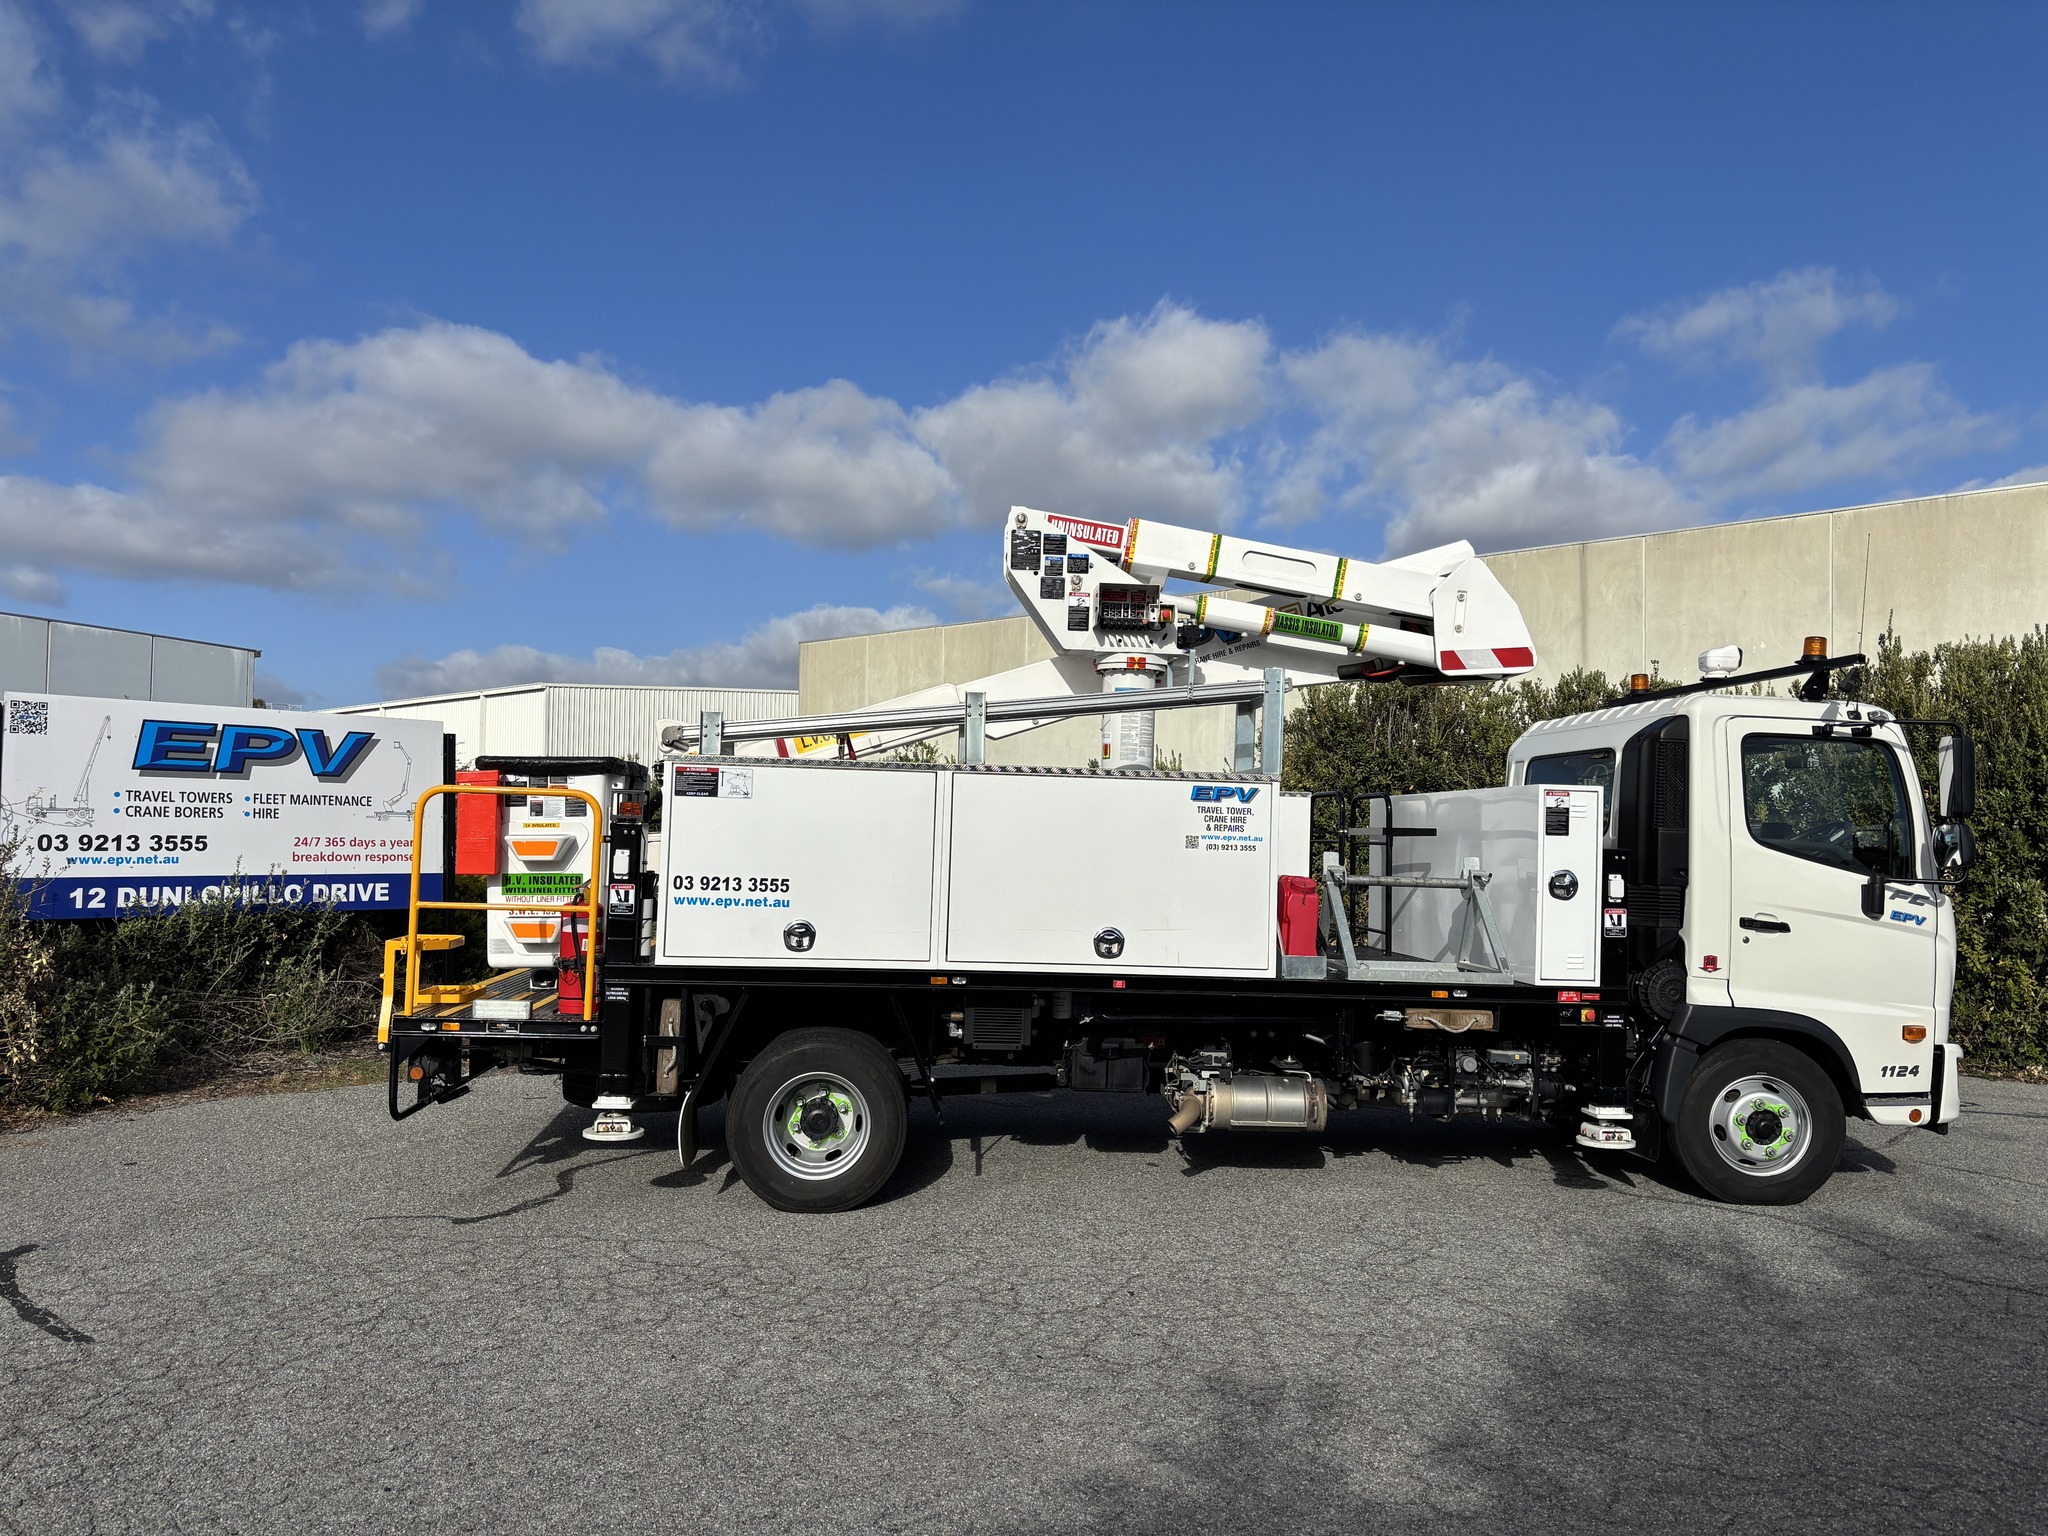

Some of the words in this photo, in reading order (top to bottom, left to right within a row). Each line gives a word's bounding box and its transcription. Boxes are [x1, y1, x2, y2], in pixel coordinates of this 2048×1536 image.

[1301, 619, 1339, 638] INSULATOR
[1194, 653, 1211, 664] RANE
[1212, 649, 1227, 660] HIRE
[1228, 647, 1233, 655] &
[1234, 639, 1261, 653] REPAIRS
[131, 719, 381, 784] EPV
[125, 790, 176, 803] TRAVEL
[179, 791, 233, 804] TOWERS
[253, 793, 287, 805] FLEET
[290, 794, 372, 807] MAINTENANCE
[1190, 785, 1261, 804] EPV
[125, 805, 170, 818] CRANE
[174, 806, 224, 819] BORERS
[252, 808, 280, 819] HIRE
[1197, 806, 1224, 814] TRAVEL
[1226, 807, 1254, 816] TOWER,
[1204, 814, 1228, 823] CRANE
[1230, 815, 1247, 824] HIRE
[1206, 824, 1212, 832] &
[1214, 824, 1244, 832] REPAIRS
[37, 834, 69, 852] 03
[78, 834, 140, 852] 9213
[149, 834, 208, 852] 3555
[294, 836, 321, 848] 24/7
[325, 837, 346, 848] 365
[349, 837, 376, 851] days
[379, 840, 387, 848] a
[390, 839, 414, 851] year
[1201, 834, 1263, 842] www.epv.net.au
[66, 855, 179, 866] www.epv.net.au
[292, 851, 361, 864] breakdown
[505, 875, 526, 886] H.V.
[528, 875, 581, 886] INSULATED
[673, 875, 694, 890] 03
[700, 876, 742, 891] 9213
[748, 877, 790, 893] 3555
[69, 887, 106, 909] 12
[312, 882, 390, 903] DRIVE
[505, 895, 535, 903] WITHOUT
[674, 896, 790, 908] www.epv.net.au
[1889, 909, 1927, 926] EPV
[1880, 1064, 1920, 1078] 1124
